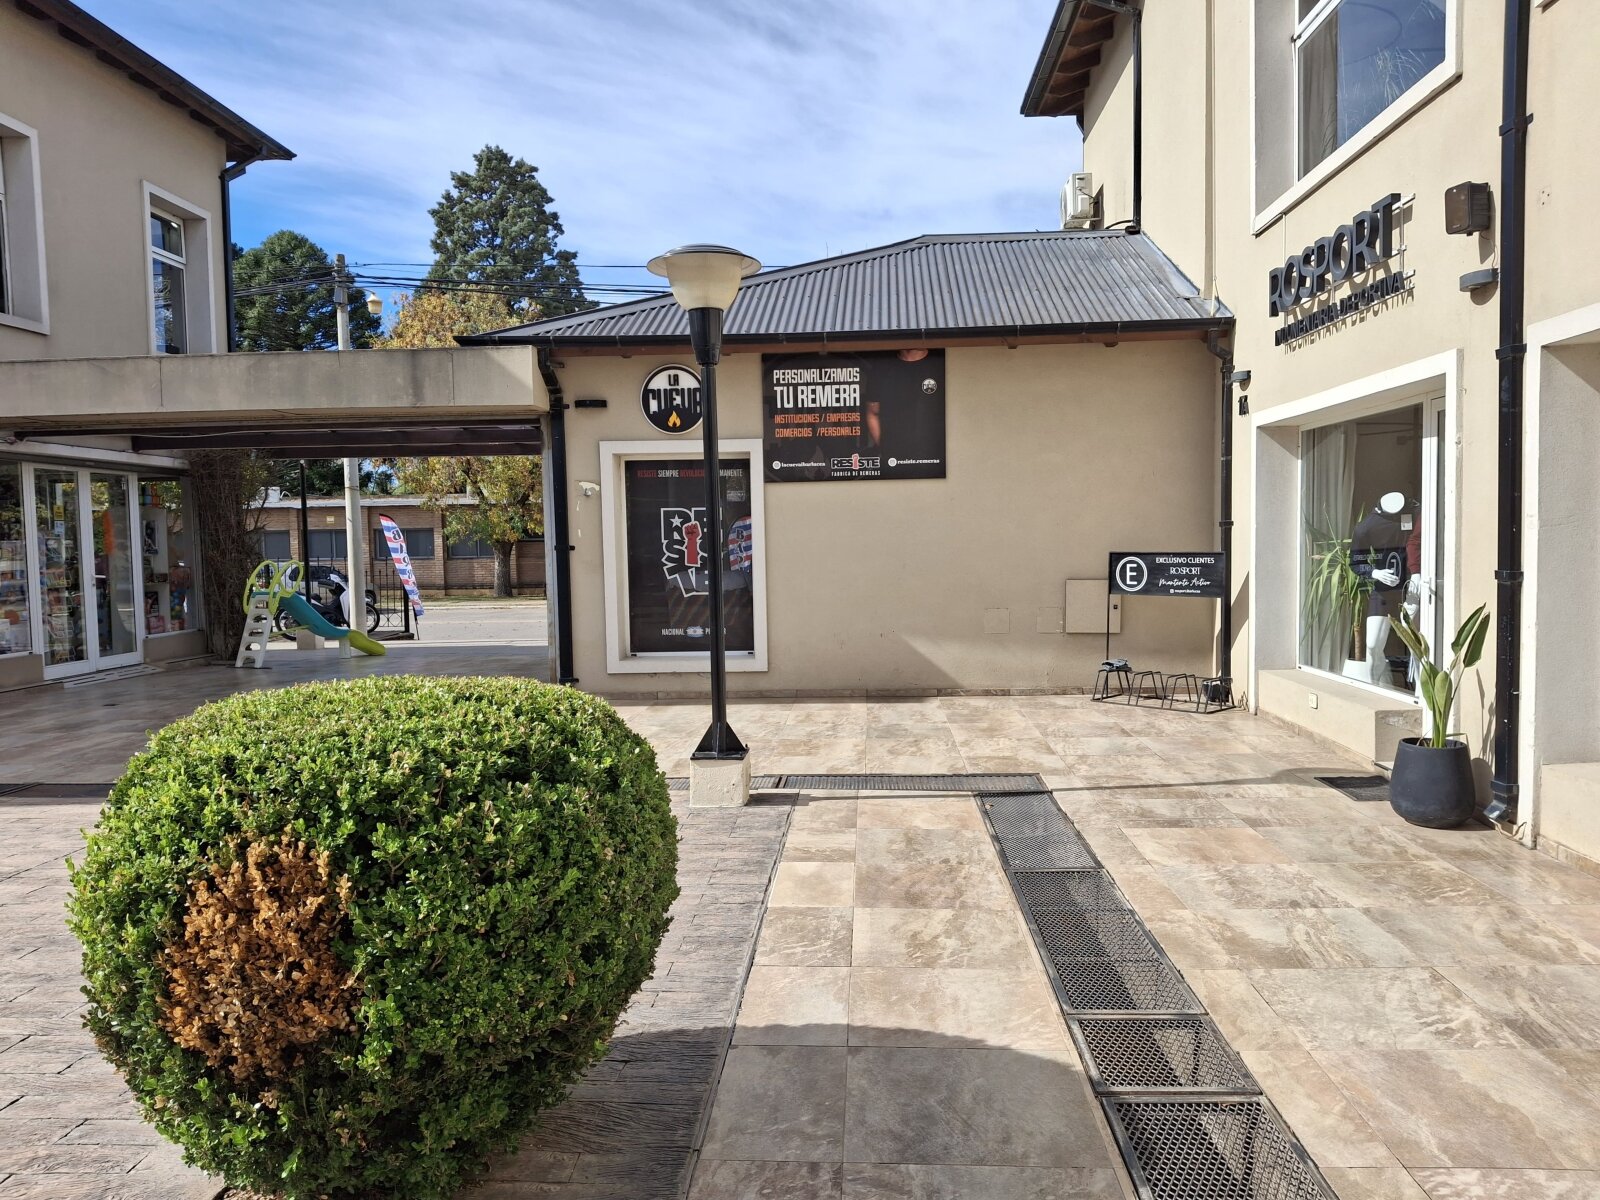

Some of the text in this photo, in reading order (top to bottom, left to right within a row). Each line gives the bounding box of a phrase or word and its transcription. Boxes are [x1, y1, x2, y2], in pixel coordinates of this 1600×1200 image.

[1269, 193, 1401, 317] ROSPORT
[1275, 271, 1406, 346] INDUMENTARIA DEPORTIVA
[668, 373, 680, 387] LA
[773, 367, 860, 384] PERSONALIZAMOS
[646, 387, 702, 415] CUEVA
[773, 384, 860, 408] TU REMERA
[774, 413, 820, 424] INSTITUCIONES
[826, 412, 861, 423] EMPRESAS
[775, 427, 813, 437] COMERCIOS
[830, 454, 880, 469] RESISTE
[657, 469, 679, 478] SIEMPRE
[719, 468, 743, 477] MANENTE
[1126, 563, 1138, 585] E
[1169, 567, 1201, 575] ROSPORT
[661, 628, 685, 636] NACIONAL
